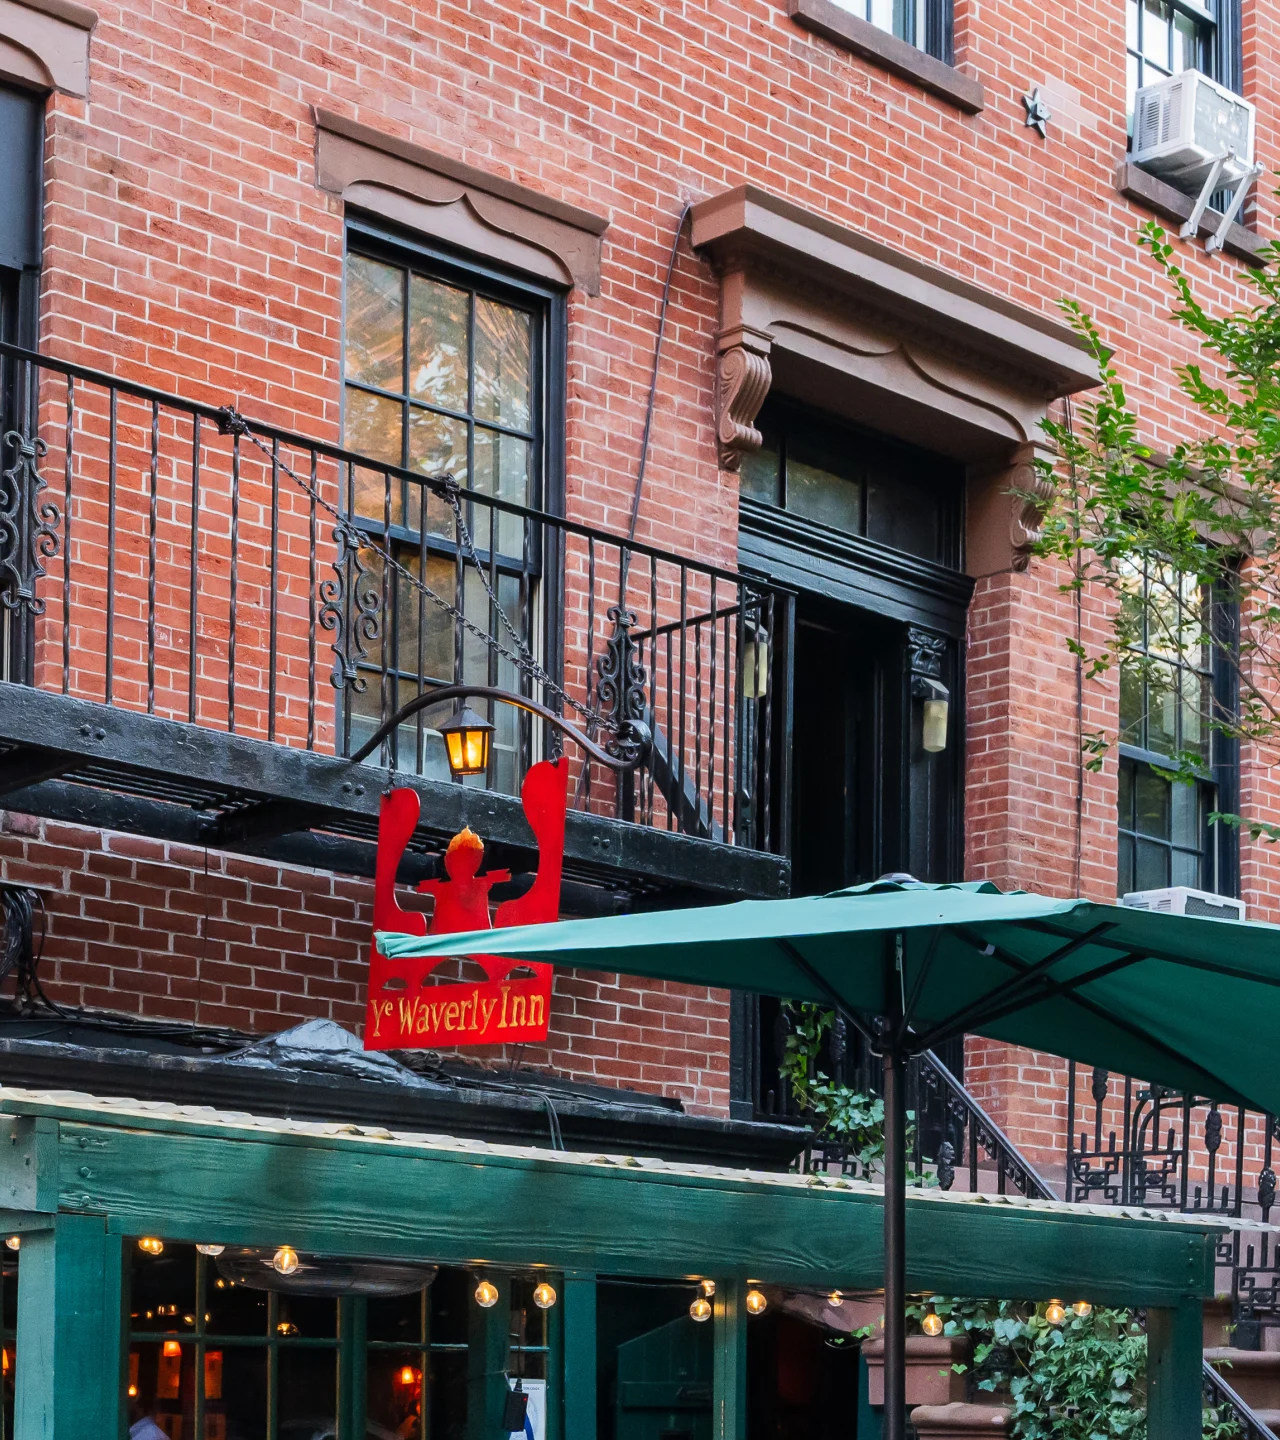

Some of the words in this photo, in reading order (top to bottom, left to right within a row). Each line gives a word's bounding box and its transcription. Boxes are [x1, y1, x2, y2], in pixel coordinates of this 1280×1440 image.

[370, 999, 393, 1037] Ye
[398, 989, 498, 1035] Waverly
[497, 986, 545, 1029] Inn
